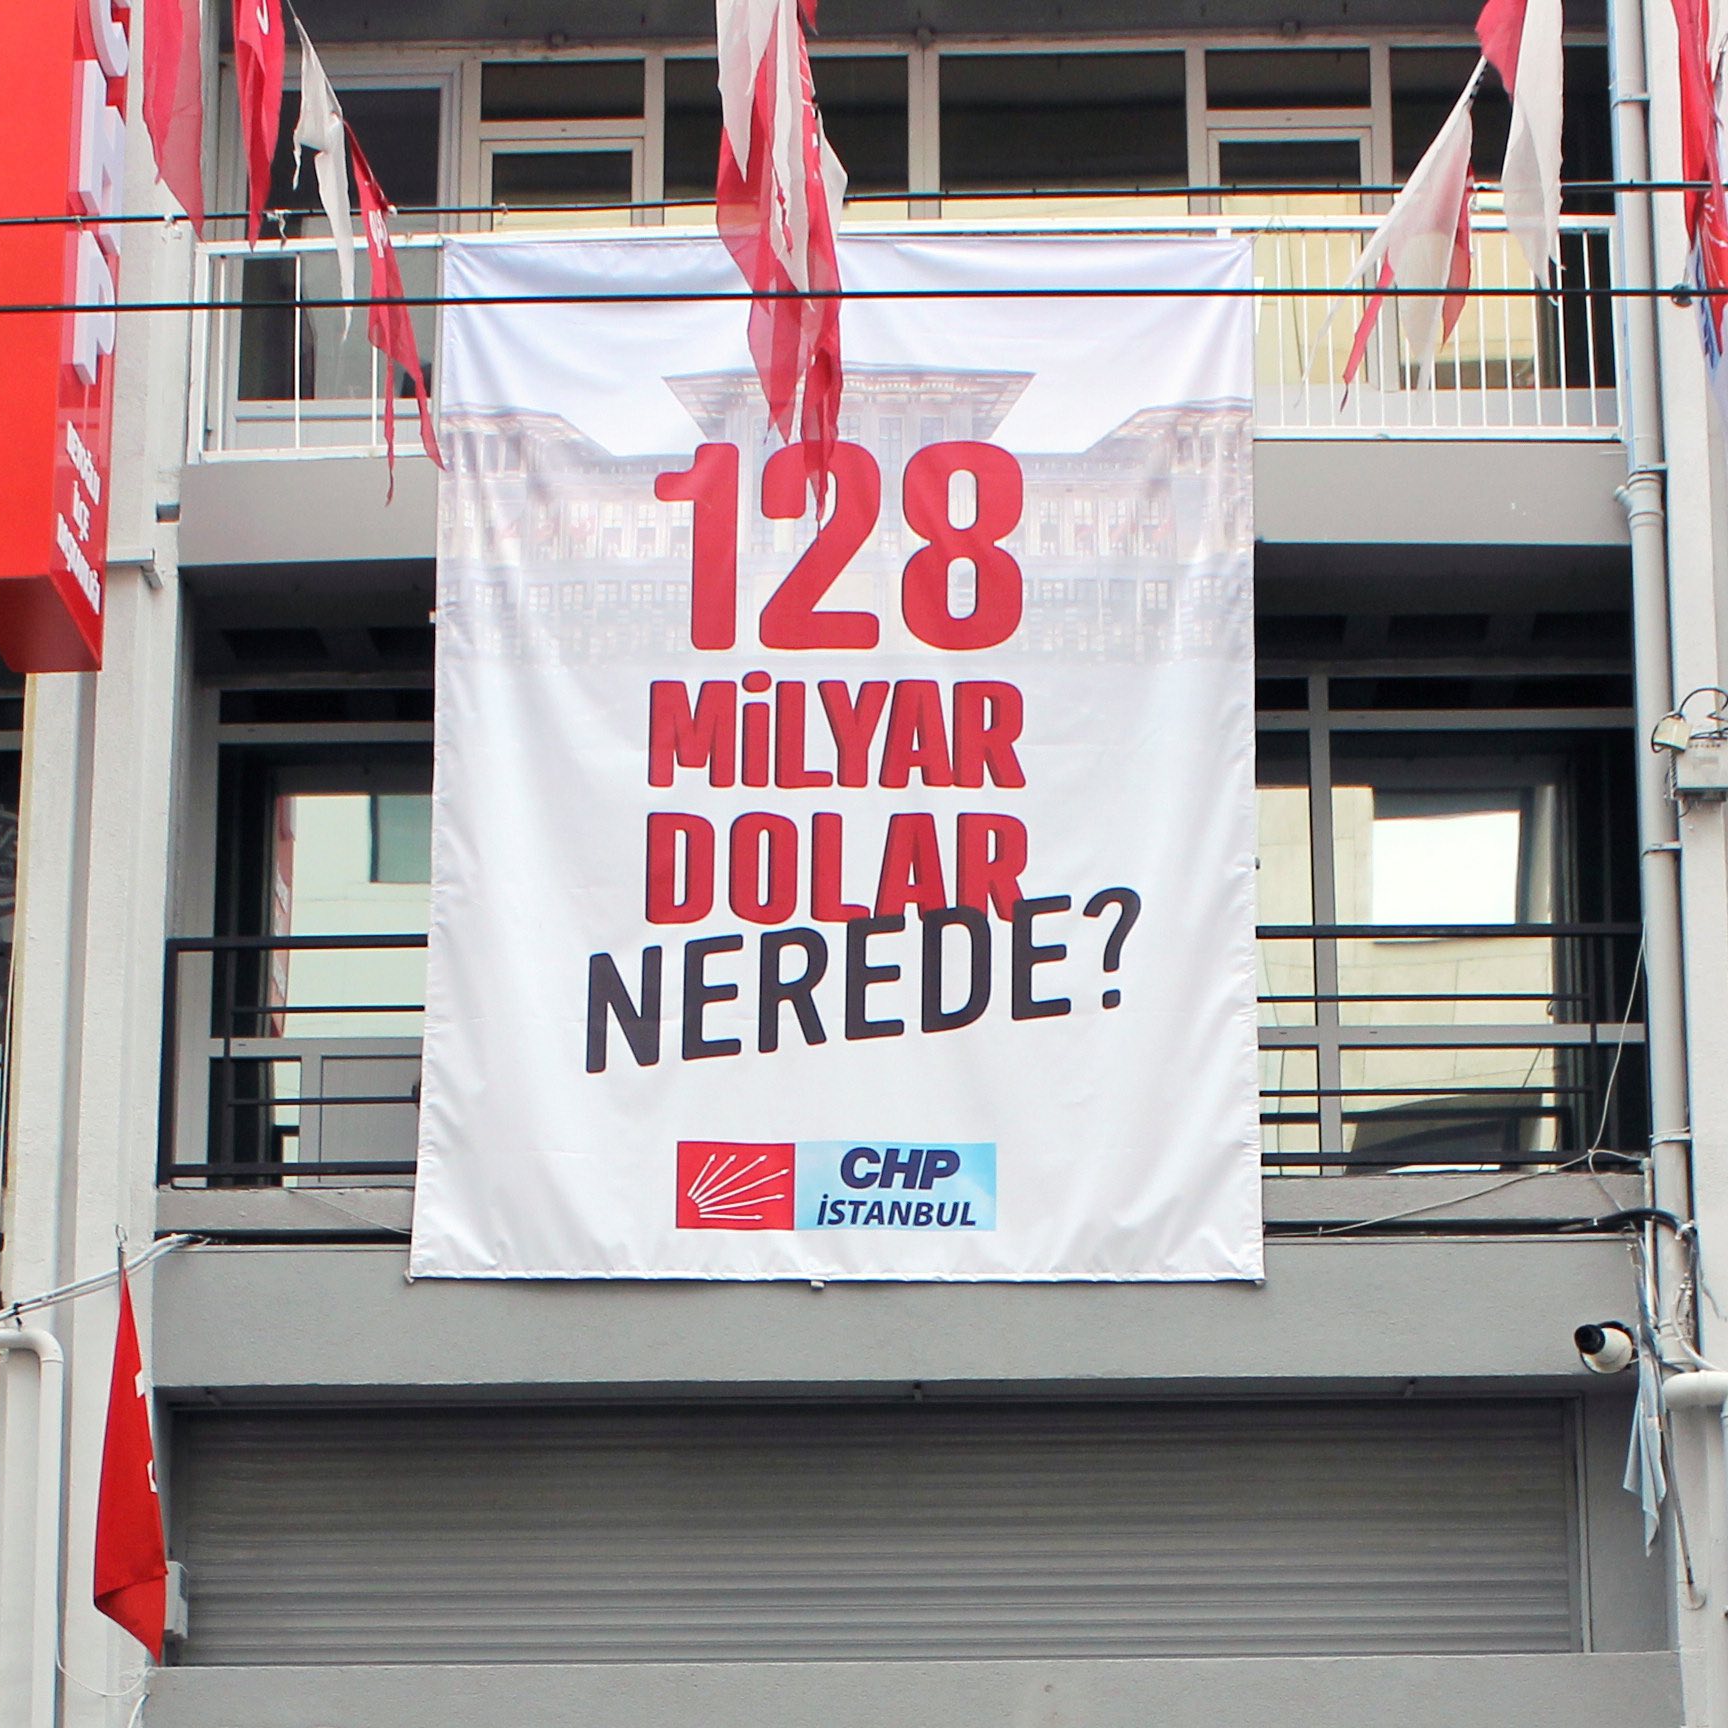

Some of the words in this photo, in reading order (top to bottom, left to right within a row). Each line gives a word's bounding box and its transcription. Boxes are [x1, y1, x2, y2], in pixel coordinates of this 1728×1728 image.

[653, 440, 1024, 651] 128
[644, 812, 1028, 925] DOLAR
[585, 886, 1142, 1075] NEREDE?
[816, 1193, 977, 1227] İSTANBUL
[840, 1146, 962, 1191] CHP
